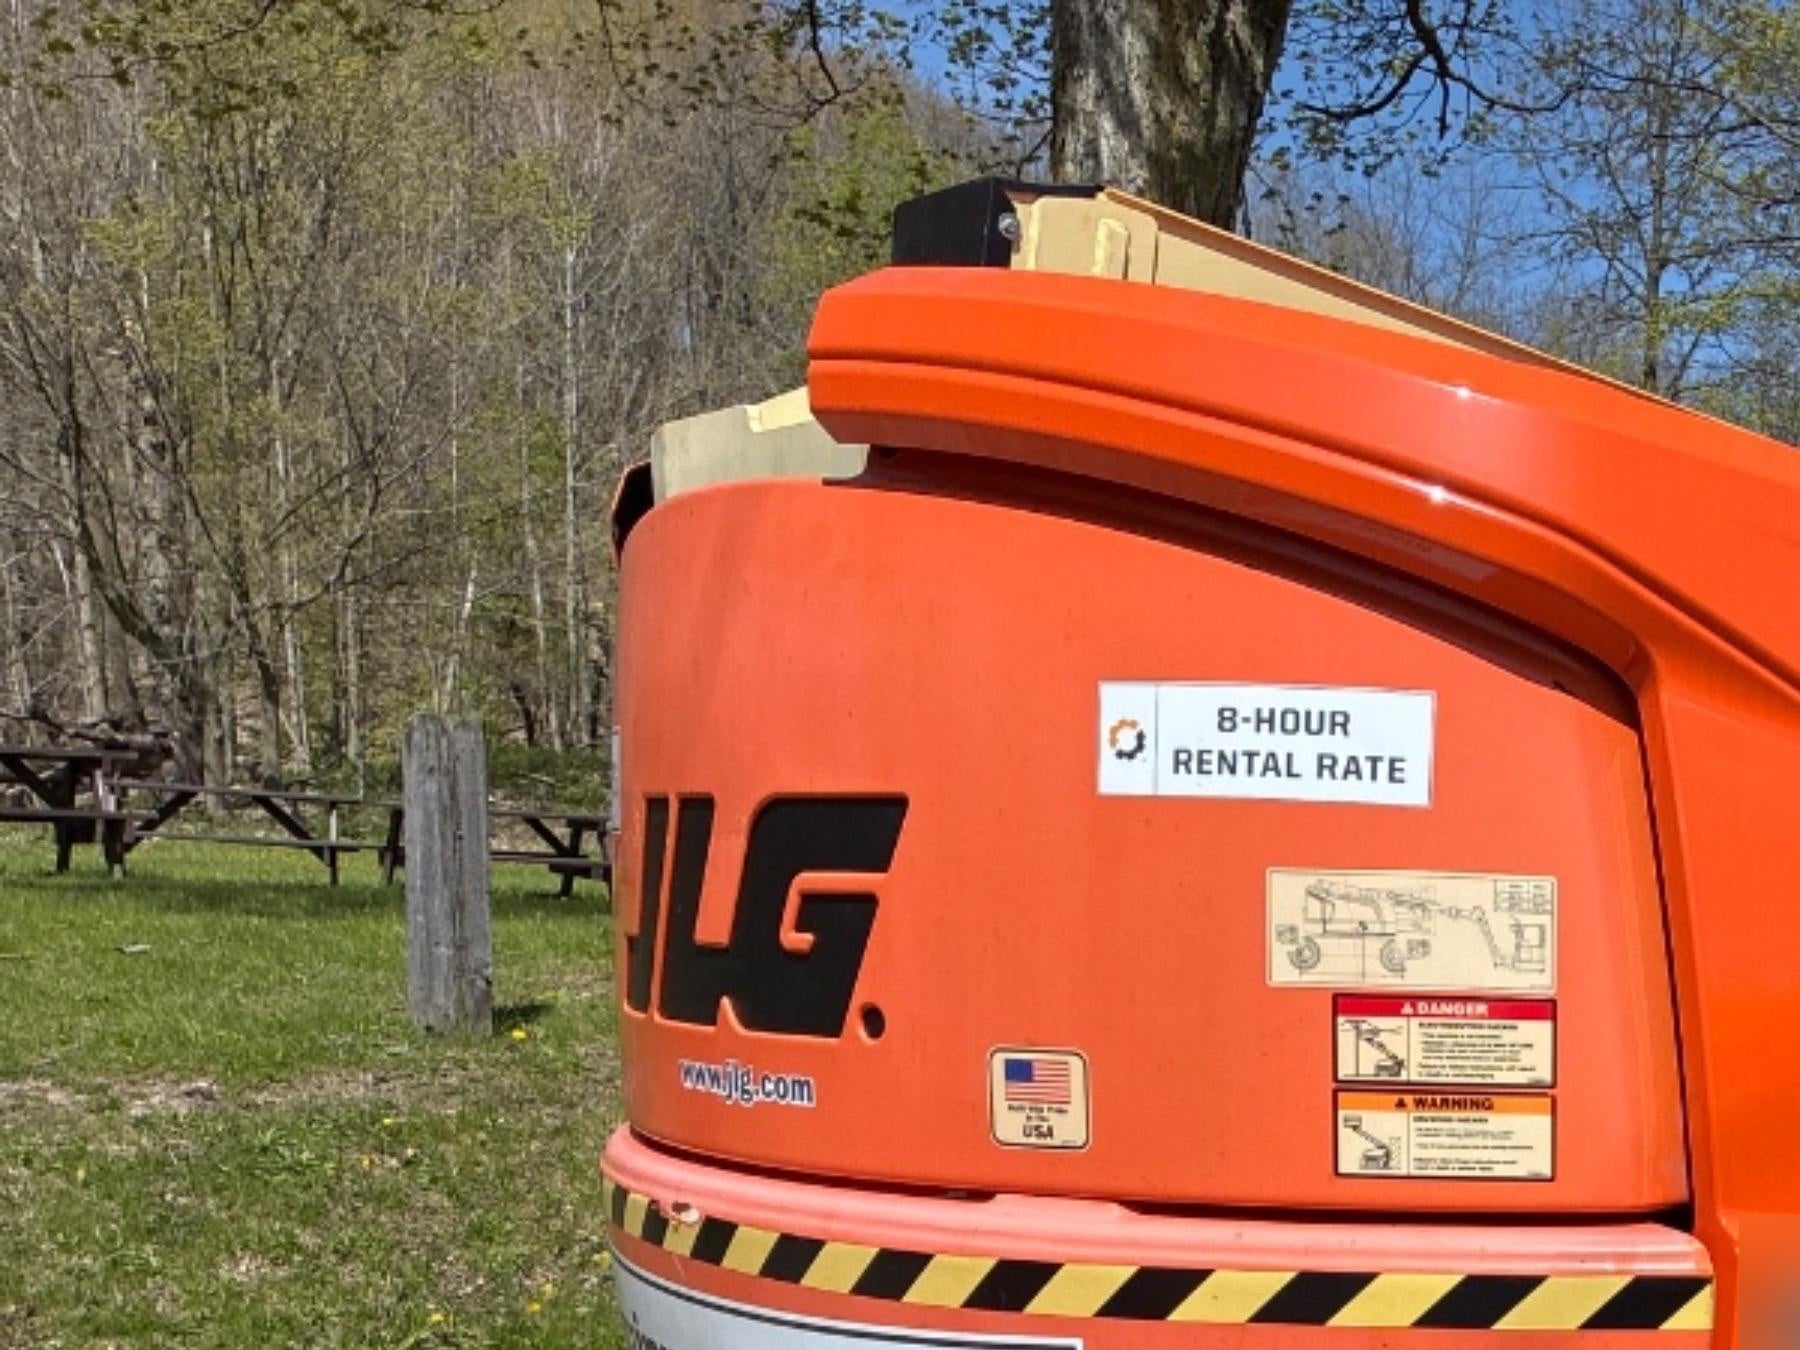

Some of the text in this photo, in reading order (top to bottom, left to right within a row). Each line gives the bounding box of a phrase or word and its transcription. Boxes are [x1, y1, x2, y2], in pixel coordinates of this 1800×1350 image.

[1217, 707, 1351, 737] 8-HOUR
[1172, 749, 1406, 783] RENTAL RATE
[1416, 1001, 1489, 1017] DANGER
[680, 1060, 815, 1106] www.jlg.com
[1412, 1096, 1495, 1112] WARNING
[1022, 1123, 1054, 1140] USA
